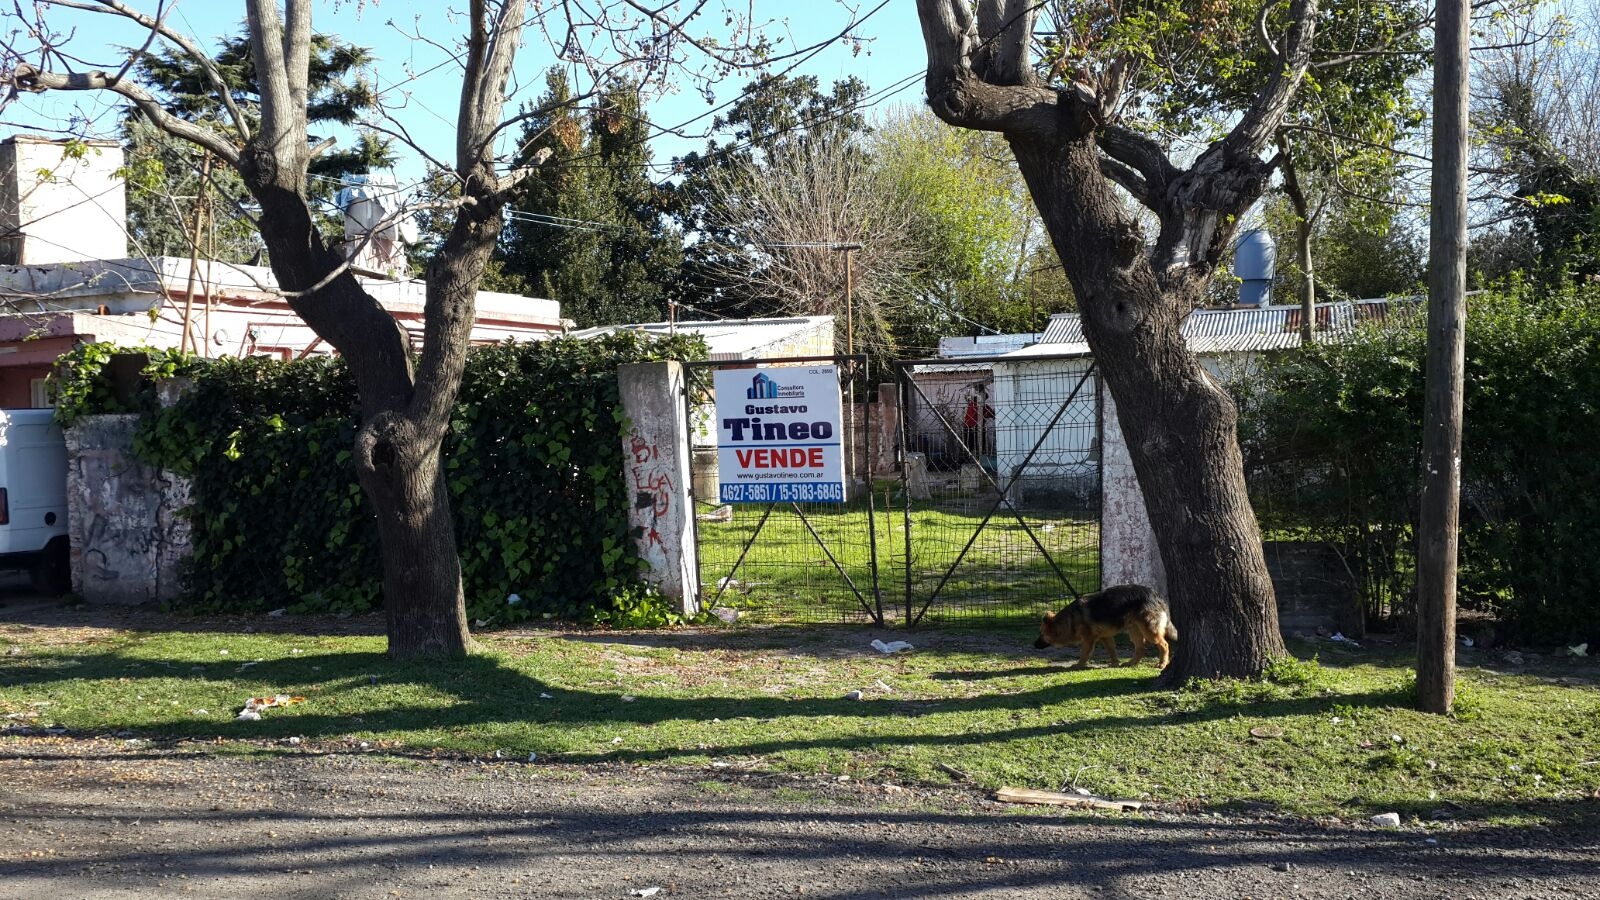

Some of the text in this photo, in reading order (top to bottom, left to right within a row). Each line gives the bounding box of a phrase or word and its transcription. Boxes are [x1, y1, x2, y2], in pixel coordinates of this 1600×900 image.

[777, 384, 805, 392] Consultora
[745, 404, 808, 415] Gustavo
[723, 417, 833, 441] Tineo
[735, 447, 825, 469] VENDE
[737, 471, 824, 481] www.gustavotineo.com.ar
[722, 484, 770, 501] 4627-5851
[779, 483, 841, 500] 15-5183-6846
